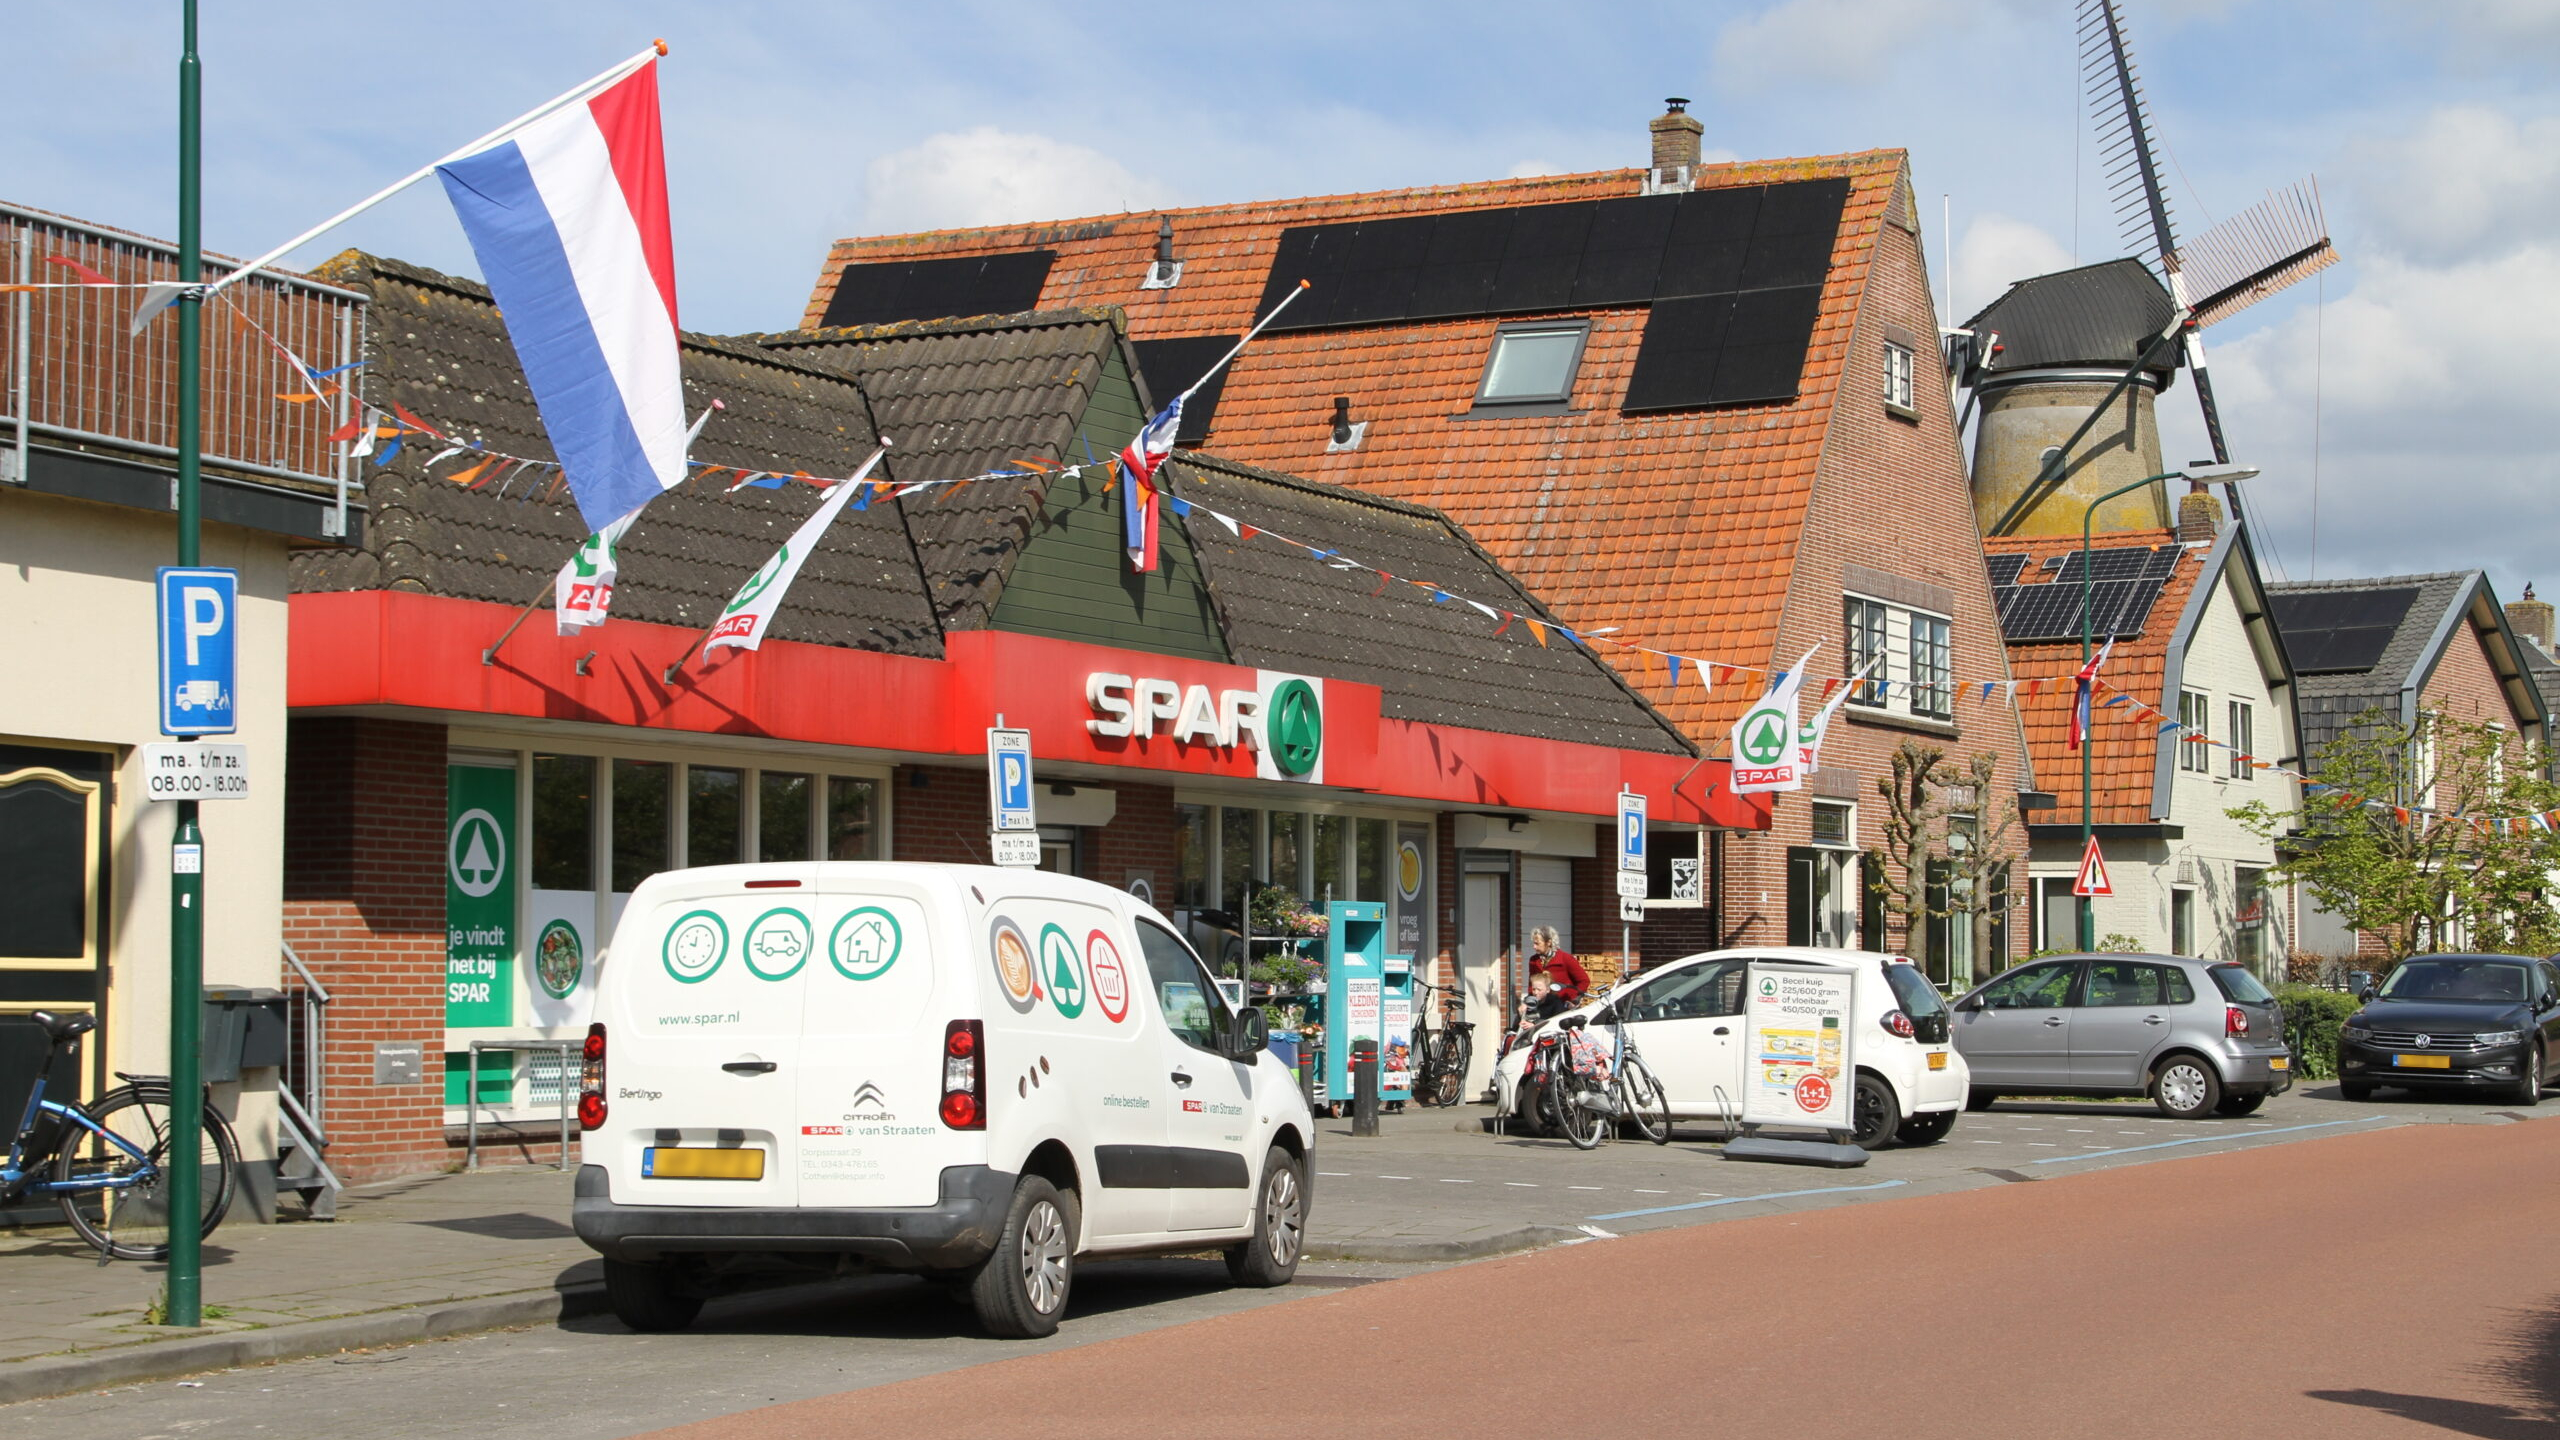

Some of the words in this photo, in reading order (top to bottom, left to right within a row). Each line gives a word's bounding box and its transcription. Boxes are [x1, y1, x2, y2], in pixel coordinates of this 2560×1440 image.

[184, 587, 224, 665] P
[712, 617, 752, 639] PAR
[1086, 672, 1264, 751] SPAR
[1002, 736, 1020, 747] ZONE
[161, 755, 192, 768] ma.
[200, 750, 222, 769] t/m
[226, 756, 241, 769] za.
[1736, 768, 1792, 783] SPAR
[151, 775, 202, 792] 08.00
[214, 775, 248, 792] 18.00h
[1002, 840, 1012, 848] ma
[1013, 838, 1025, 849] t/m
[1673, 860, 1697, 868] PEACE
[1673, 889, 1698, 899] NOW
[1400, 915, 1418, 928] vroeg
[448, 924, 464, 951] je
[466, 925, 506, 946] vindt
[449, 953, 476, 975] het
[478, 953, 497, 979] bij
[1782, 977, 1805, 985] Becel
[1806, 978, 1824, 987] kuip
[448, 982, 490, 1003] SPAR
[1782, 986, 1817, 996] 225/600
[1818, 989, 1840, 997] gram
[1349, 995, 1379, 1007] KLEDING
[1782, 996, 1790, 1004] of
[659, 1010, 741, 1027] www.spar.nl
[619, 1087, 663, 1101] Berlingo
[1801, 1085, 1828, 1099] 1+1
[1103, 1094, 1122, 1107] online
[1122, 1095, 1150, 1109] bestellen
[1209, 1104, 1219, 1114] van
[1219, 1102, 1243, 1115] Straaten
[809, 1126, 843, 1135] SPAR
[859, 1127, 880, 1136] van
[882, 1125, 936, 1136] Straaten
[643, 1164, 654, 1172] NL
